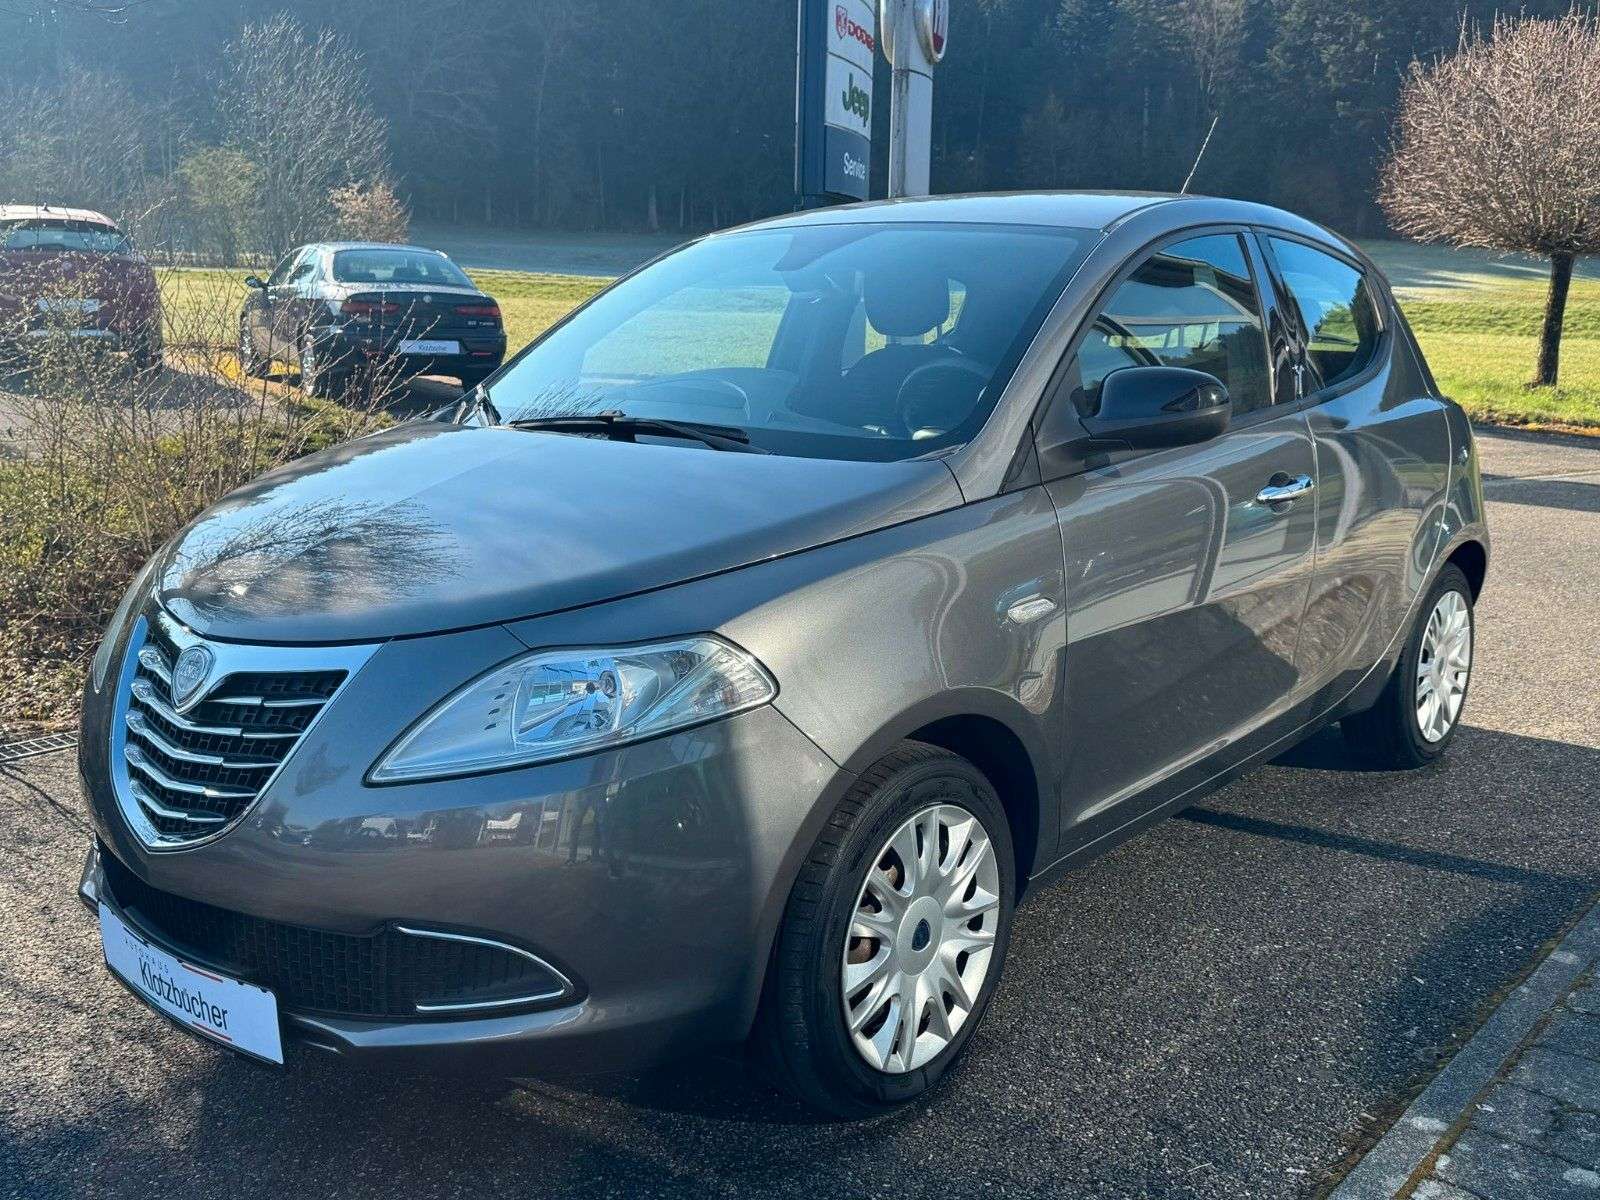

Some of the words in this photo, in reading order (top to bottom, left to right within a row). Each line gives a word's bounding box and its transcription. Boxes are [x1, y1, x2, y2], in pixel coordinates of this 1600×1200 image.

[842, 72, 870, 128] Jeep
[843, 151, 866, 180] Service
[138, 957, 228, 1030] Klotzbücher
